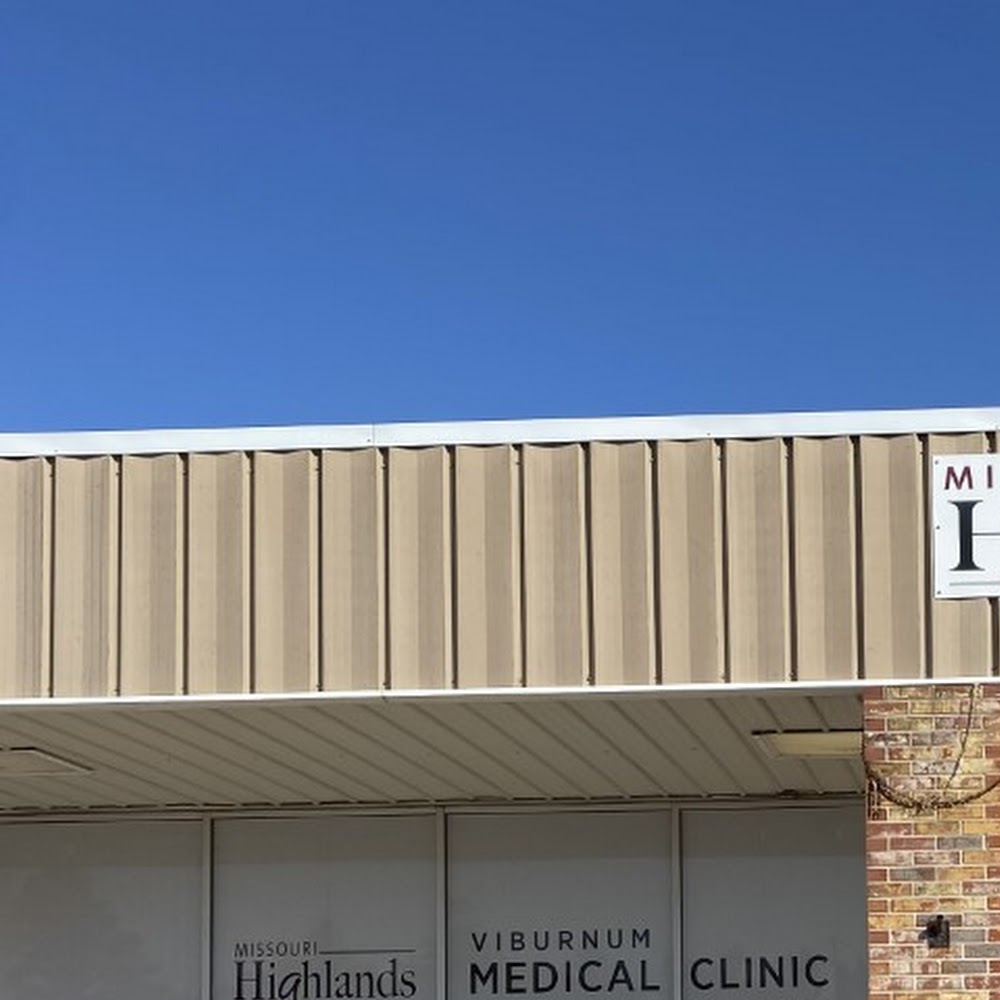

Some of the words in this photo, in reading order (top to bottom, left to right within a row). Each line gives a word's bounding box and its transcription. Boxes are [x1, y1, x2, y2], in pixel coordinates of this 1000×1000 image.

[234, 941, 318, 958] MISSOURI
[471, 928, 652, 952] VIBURNUM
[469, 959, 661, 995] MEDICAL
[689, 954, 830, 990] CLINIC
